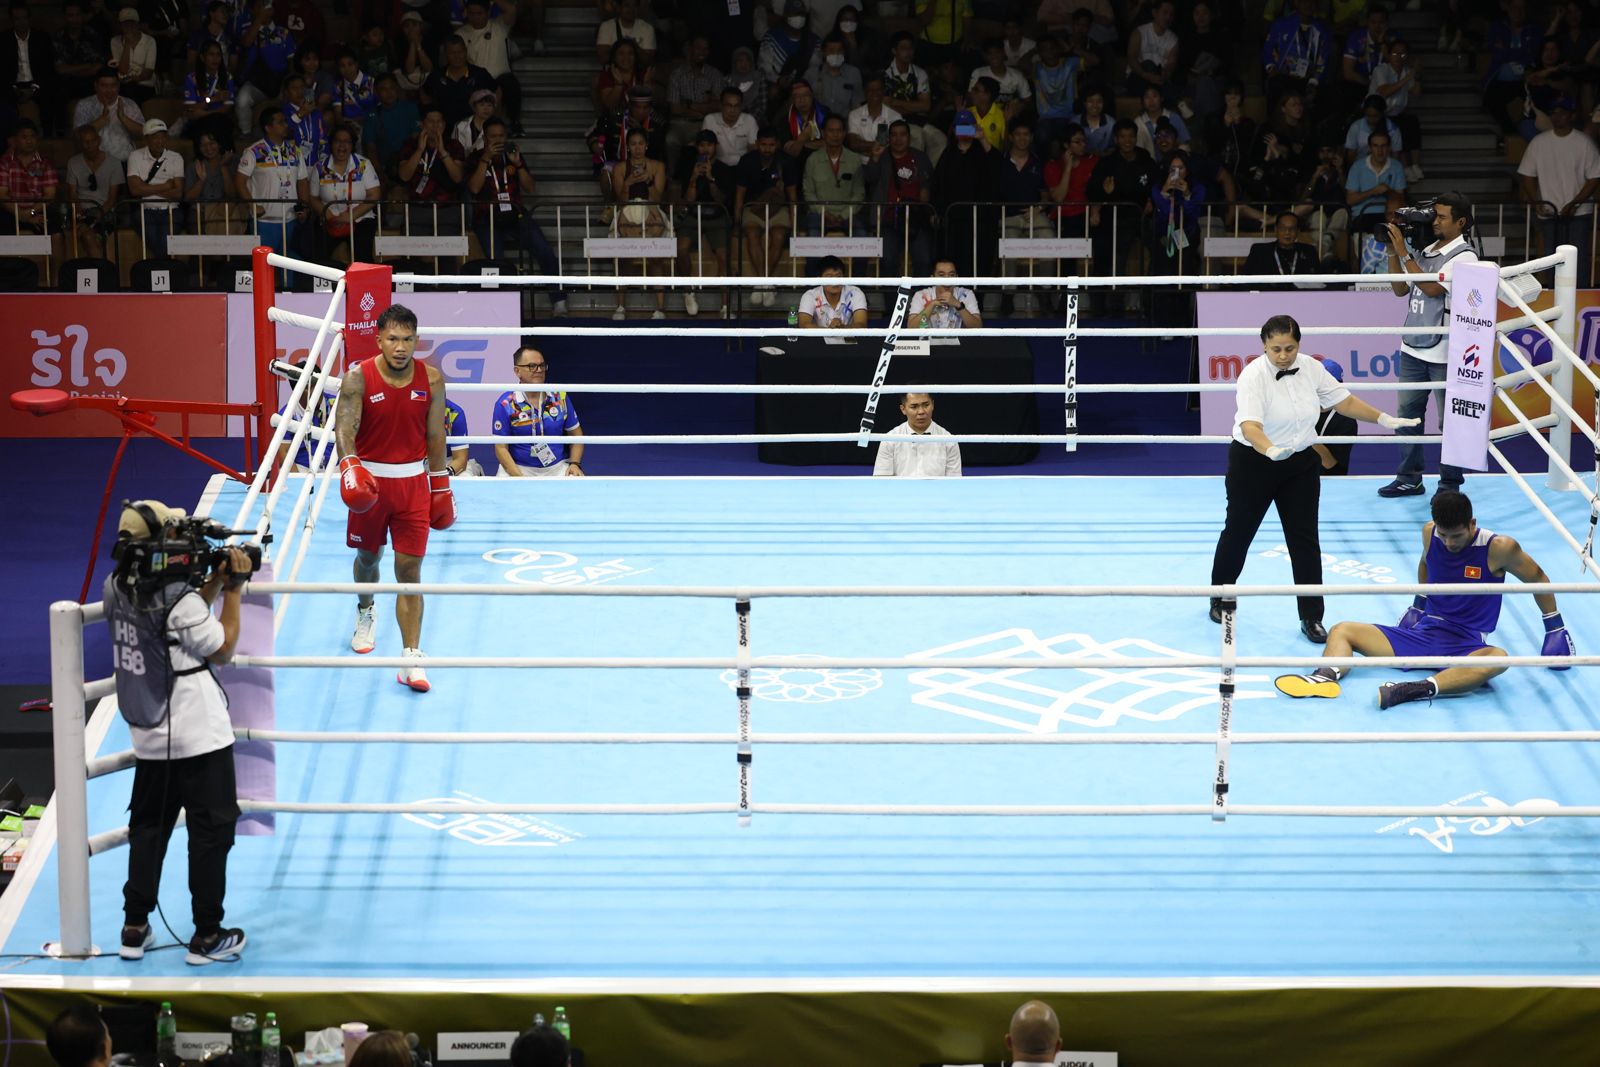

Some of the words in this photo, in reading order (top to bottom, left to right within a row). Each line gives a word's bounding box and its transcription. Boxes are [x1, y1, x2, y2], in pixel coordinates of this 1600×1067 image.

[84, 277, 91, 287] R
[154, 276, 166, 286] J1
[238, 276, 252, 286] J2
[315, 278, 329, 287] J3
[1381, 285, 1393, 293] BOO
[348, 319, 378, 331] THAILA
[1456, 314, 1493, 328] THAILAND
[1457, 367, 1484, 380] NSDF
[1452, 397, 1486, 412] GREEN
[1452, 405, 1481, 419] HILL
[115, 620, 139, 646] HB
[739, 612, 749, 647] SportCo
[1224, 609, 1233, 645] SportCo
[113, 645, 146, 675] 158
[1216, 763, 1226, 807] SpCom
[451, 1042, 506, 1050] ANNOUNCER
